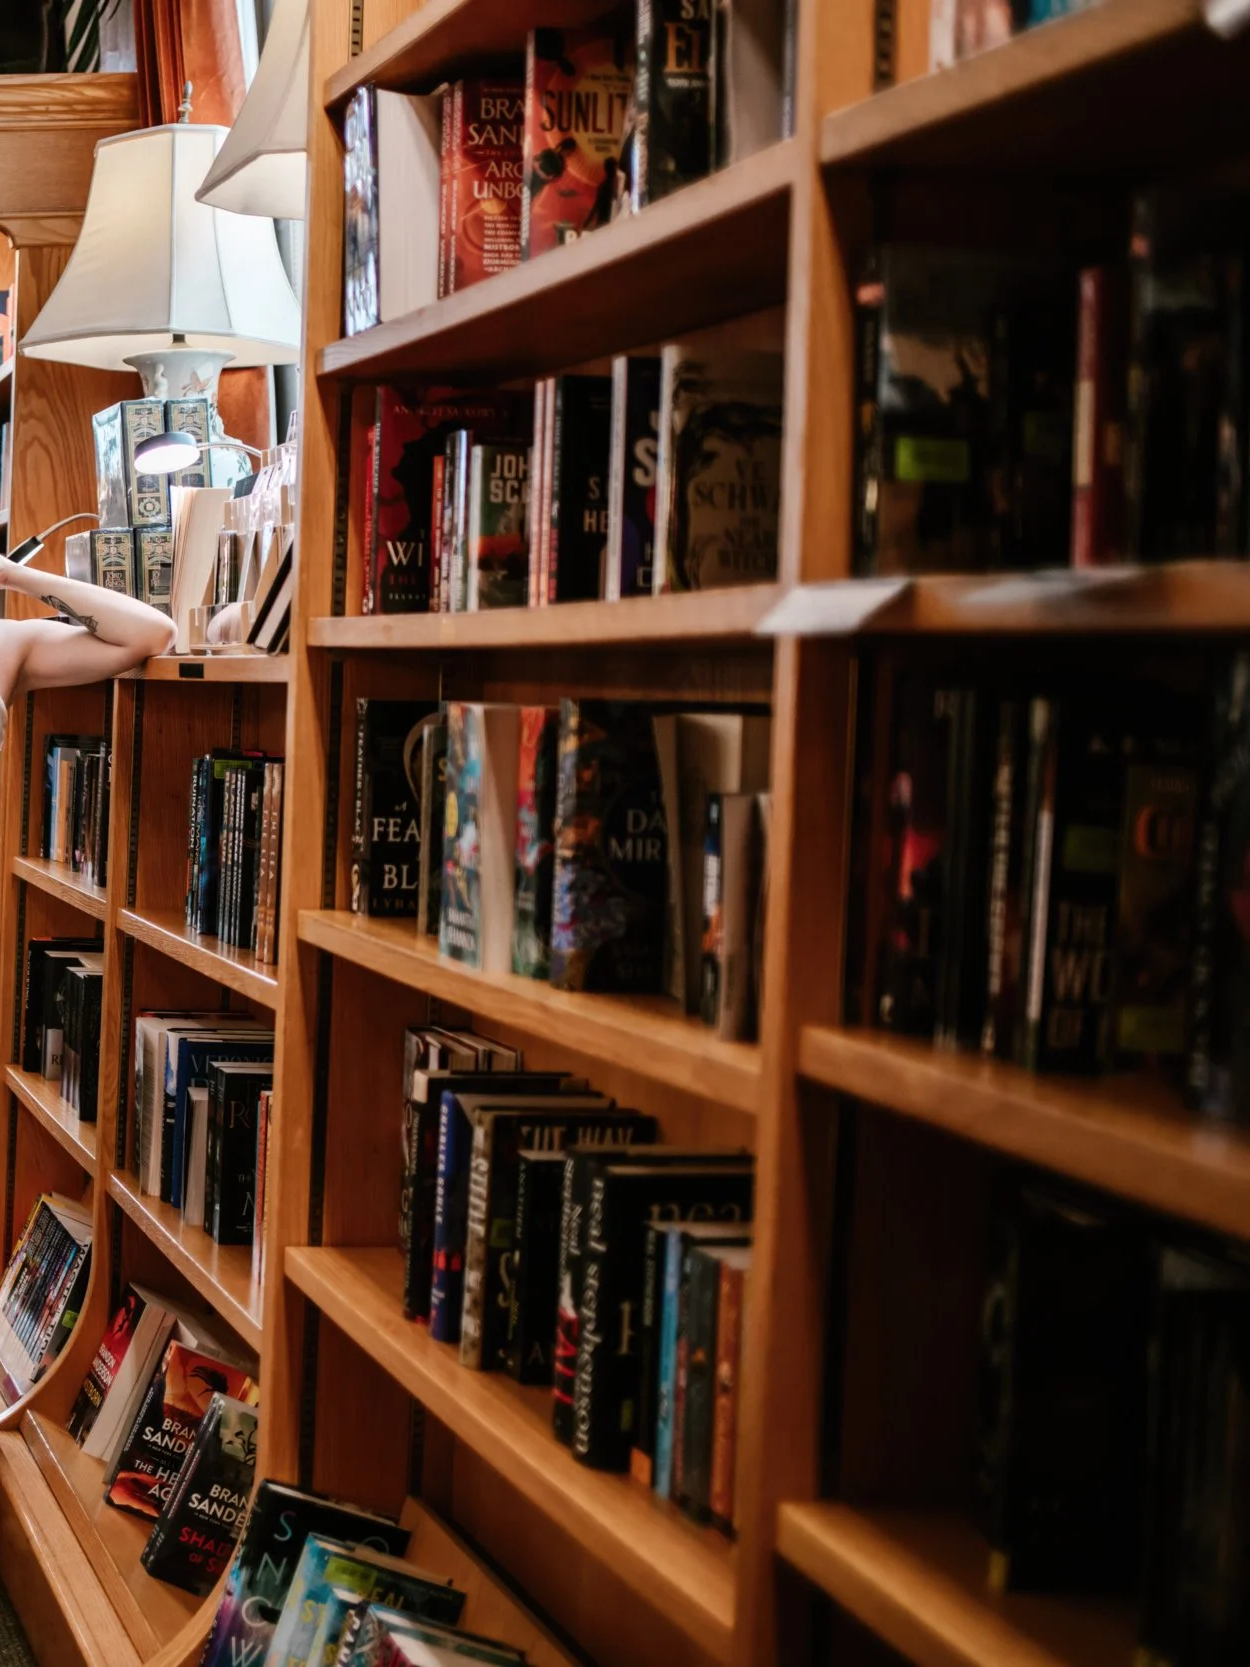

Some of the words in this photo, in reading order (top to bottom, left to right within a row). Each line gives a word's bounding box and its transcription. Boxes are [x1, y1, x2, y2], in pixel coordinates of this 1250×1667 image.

[189, 775, 197, 849] RUINATION
[589, 1177, 607, 1252] neal
[573, 1263, 603, 1456] stephenson
[134, 1459, 154, 1474] THE
